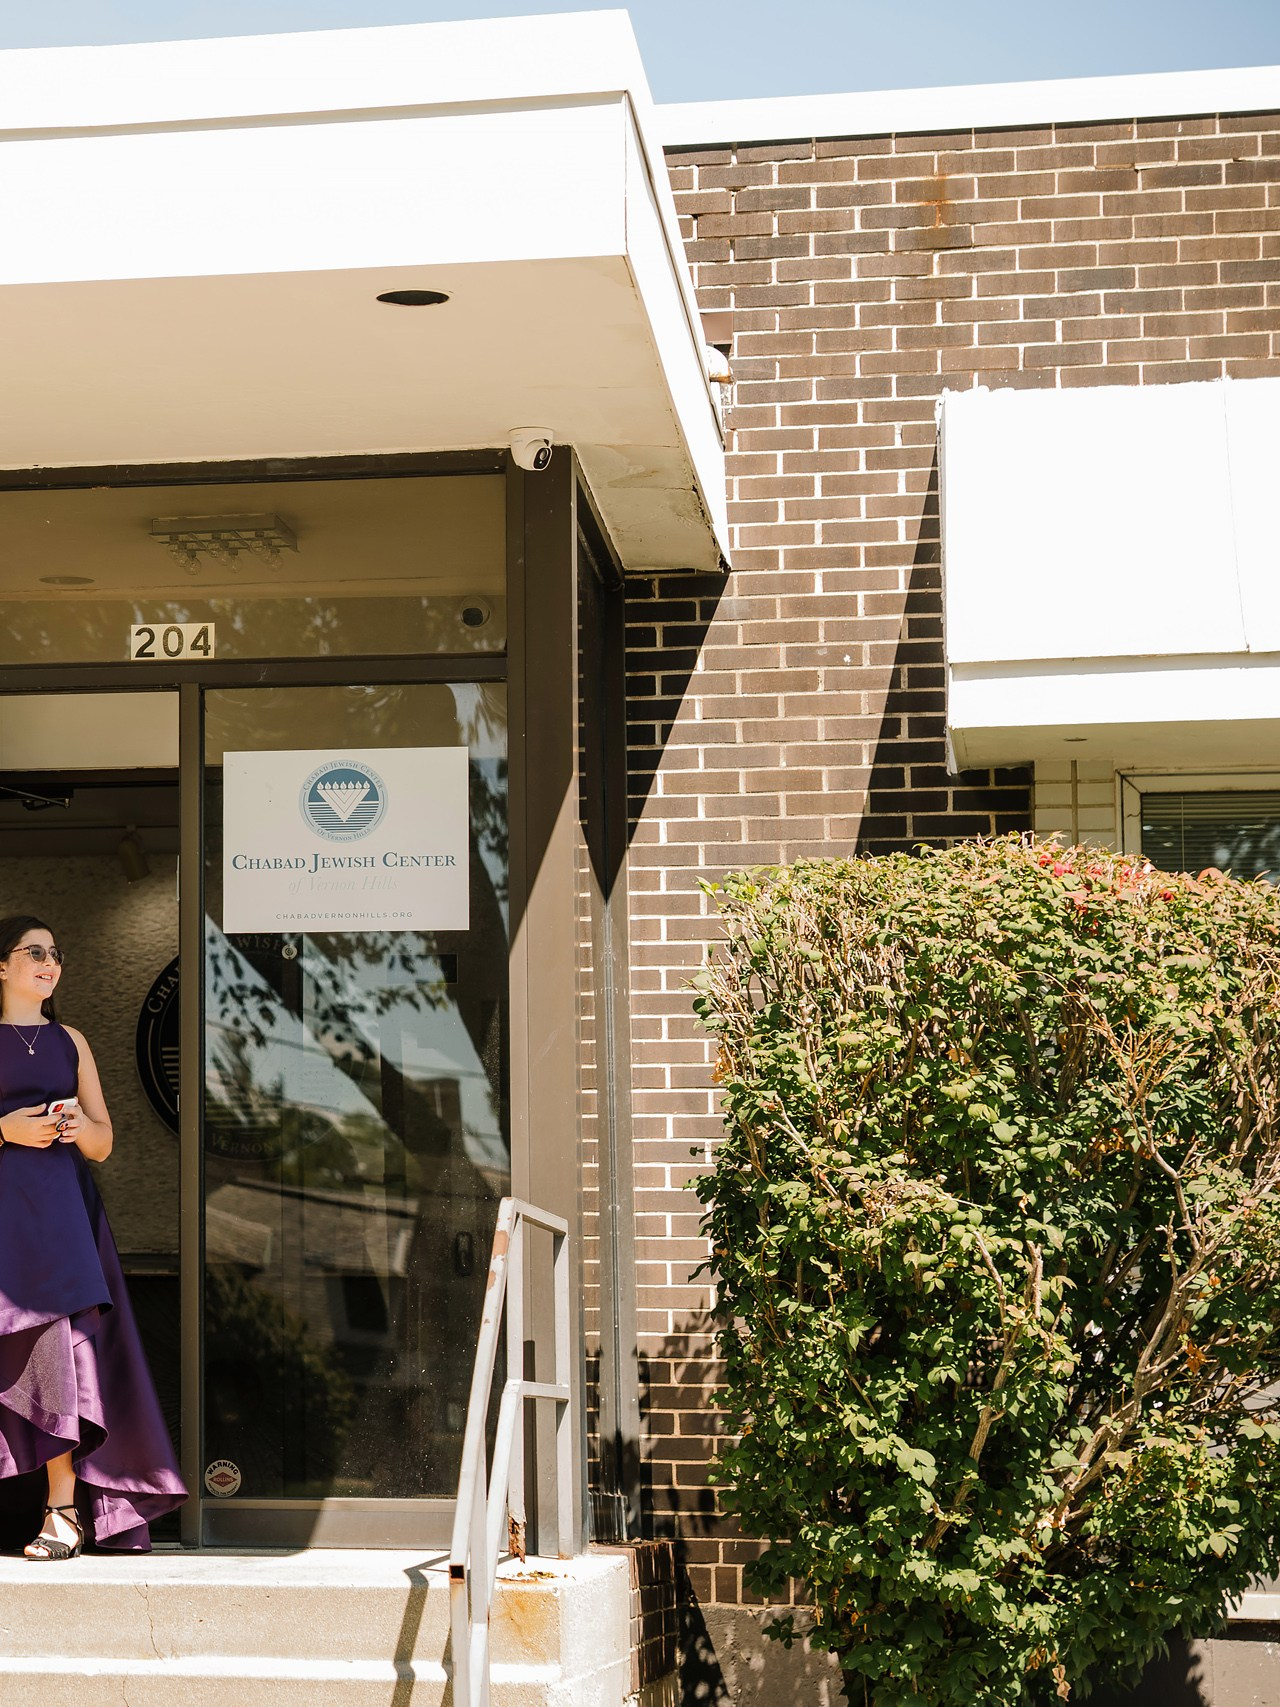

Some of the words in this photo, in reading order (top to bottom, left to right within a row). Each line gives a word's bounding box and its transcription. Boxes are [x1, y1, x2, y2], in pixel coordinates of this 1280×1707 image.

[135, 625, 211, 658] 204
[303, 766, 329, 791] CHABAD
[330, 761, 359, 769] JEWISH
[360, 765, 383, 789] CENTER
[327, 832, 352, 841] VERNON
[353, 828, 371, 840] HILLS
[232, 853, 306, 870] CHABAD
[308, 853, 376, 873] JEWISH
[382, 851, 457, 868] CENTER
[288, 876, 306, 895] of
[309, 876, 356, 892] Vernon
[361, 875, 400, 891] Hills
[275, 911, 413, 920] CHABADVERNONHILLS.ORG
[207, 1461, 239, 1475] WARNING
